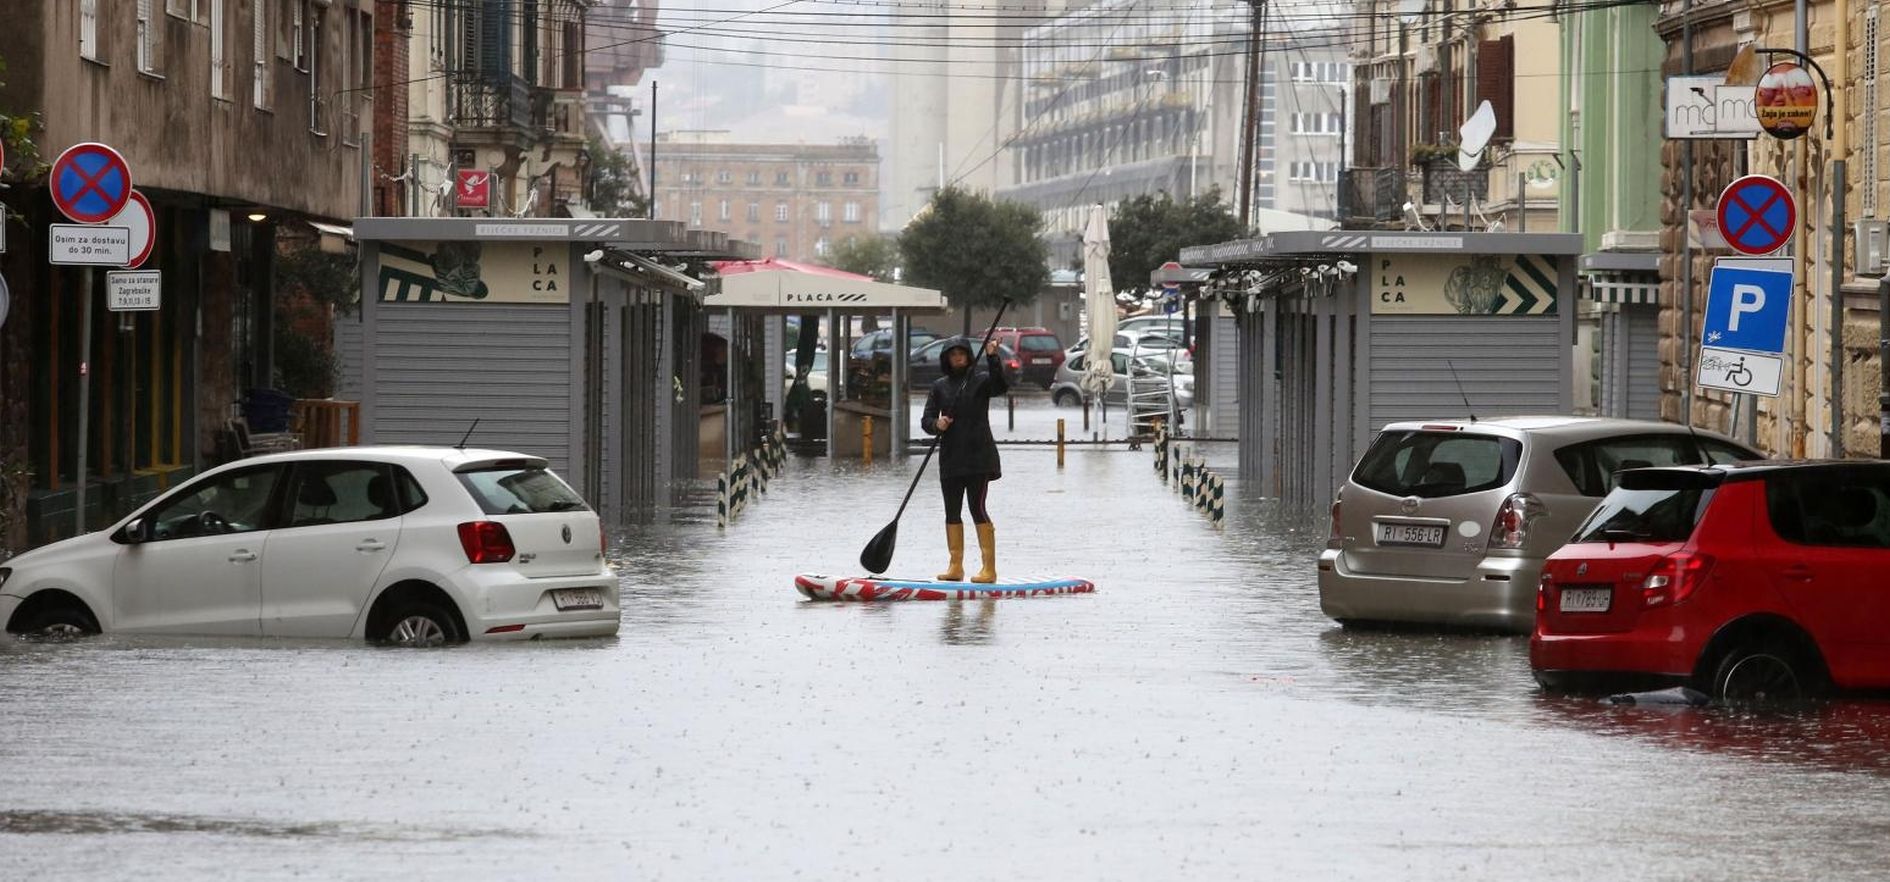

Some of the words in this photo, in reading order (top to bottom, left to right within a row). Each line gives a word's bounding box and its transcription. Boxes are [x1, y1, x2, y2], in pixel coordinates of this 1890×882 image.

[1778, 109, 1786, 120] je
[55, 235, 76, 244] Osim
[78, 236, 89, 244] za
[91, 236, 126, 245] dostavu
[68, 246, 79, 254] do
[81, 246, 92, 254] 30
[94, 246, 112, 255] min.
[787, 293, 833, 302] PLACA
[1728, 284, 1766, 332] P
[1384, 527, 1397, 540] RI
